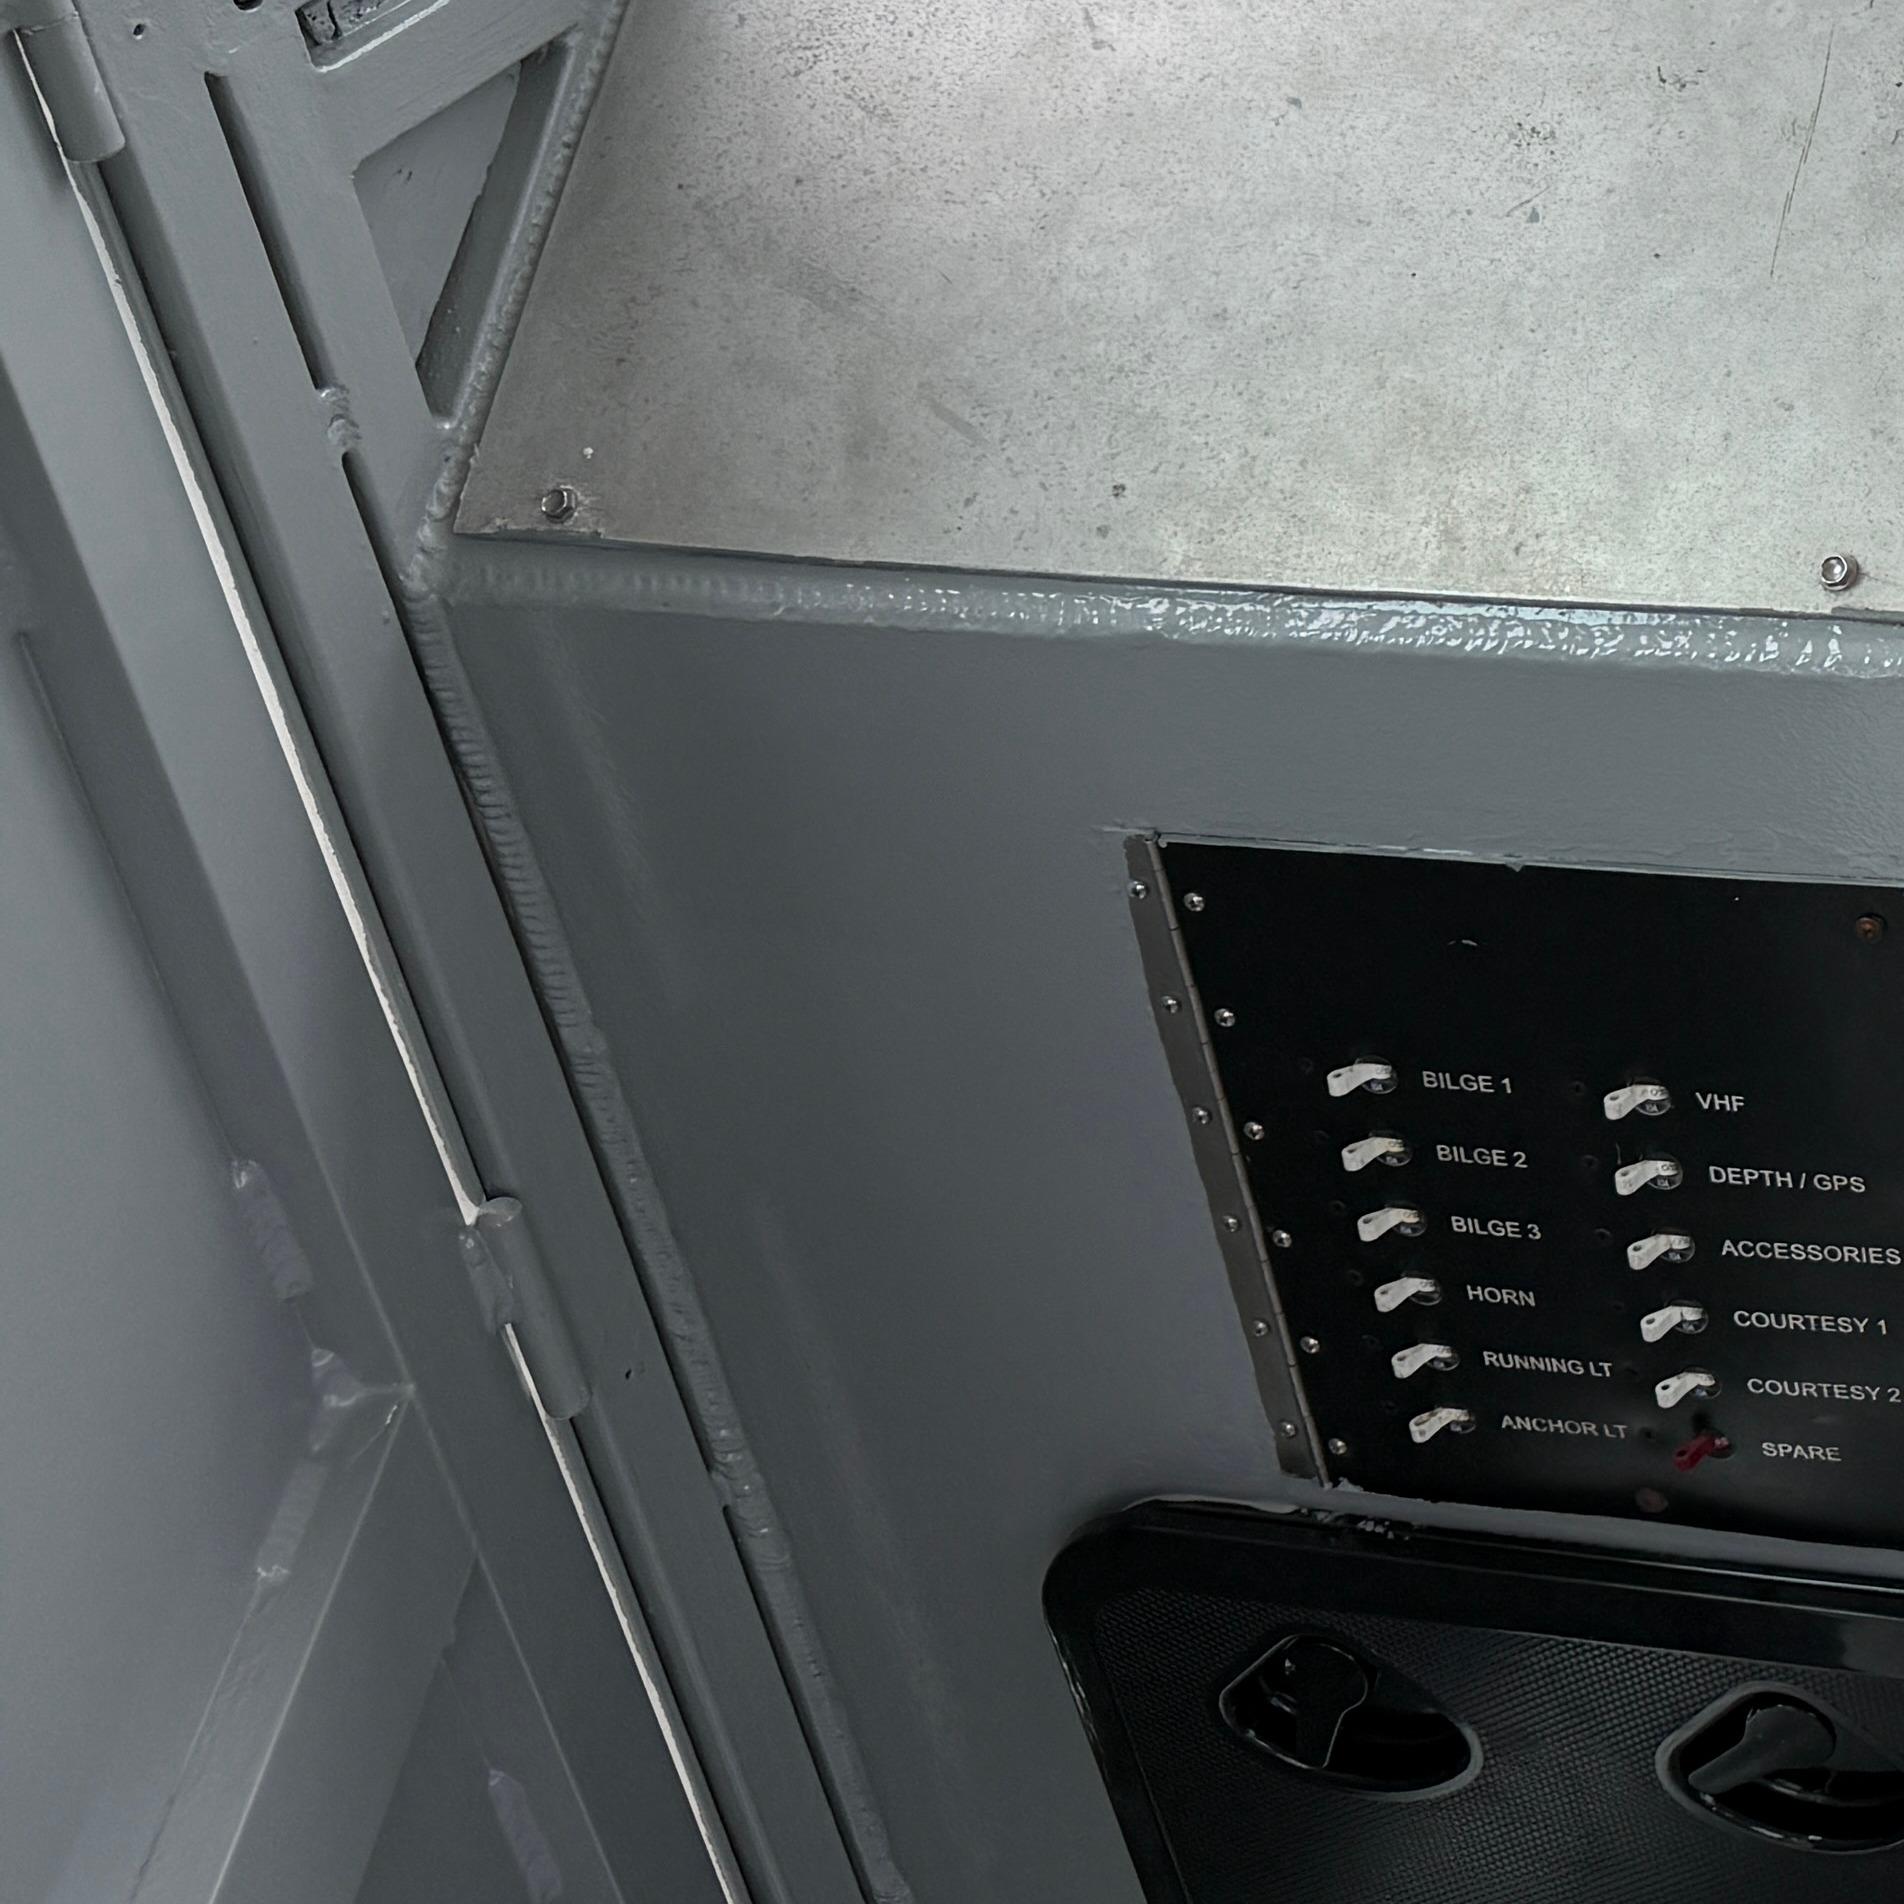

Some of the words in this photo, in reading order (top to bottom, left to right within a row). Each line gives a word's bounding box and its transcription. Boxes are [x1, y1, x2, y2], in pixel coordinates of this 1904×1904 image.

[1422, 1070, 1495, 1093] BILGE
[1501, 1077, 1512, 1094] 1
[1695, 1091, 1747, 1112] VHF
[1436, 1144, 1509, 1167] BILGE
[1512, 1151, 1528, 1169] 2
[1708, 1165, 1793, 1189] DEPTH
[1799, 1172, 1807, 1190] /
[1813, 1173, 1866, 1193] GPS
[1450, 1215, 1522, 1238] BILGE
[1527, 1223, 1542, 1240] 3
[1721, 1239, 1902, 1265] ACCESSORIES
[1466, 1284, 1536, 1307] HORN
[1733, 1310, 1869, 1334] COURTESY
[1877, 1319, 1887, 1335] 1
[1482, 1350, 1585, 1375] RUNNING
[1588, 1361, 1613, 1378] LT
[1746, 1378, 1881, 1401] COURTESY
[1887, 1387, 1902, 1403] 2
[1501, 1415, 1599, 1437] ANCHOR
[1603, 1423, 1628, 1439] LT
[1761, 1441, 1842, 1462] SPARE
